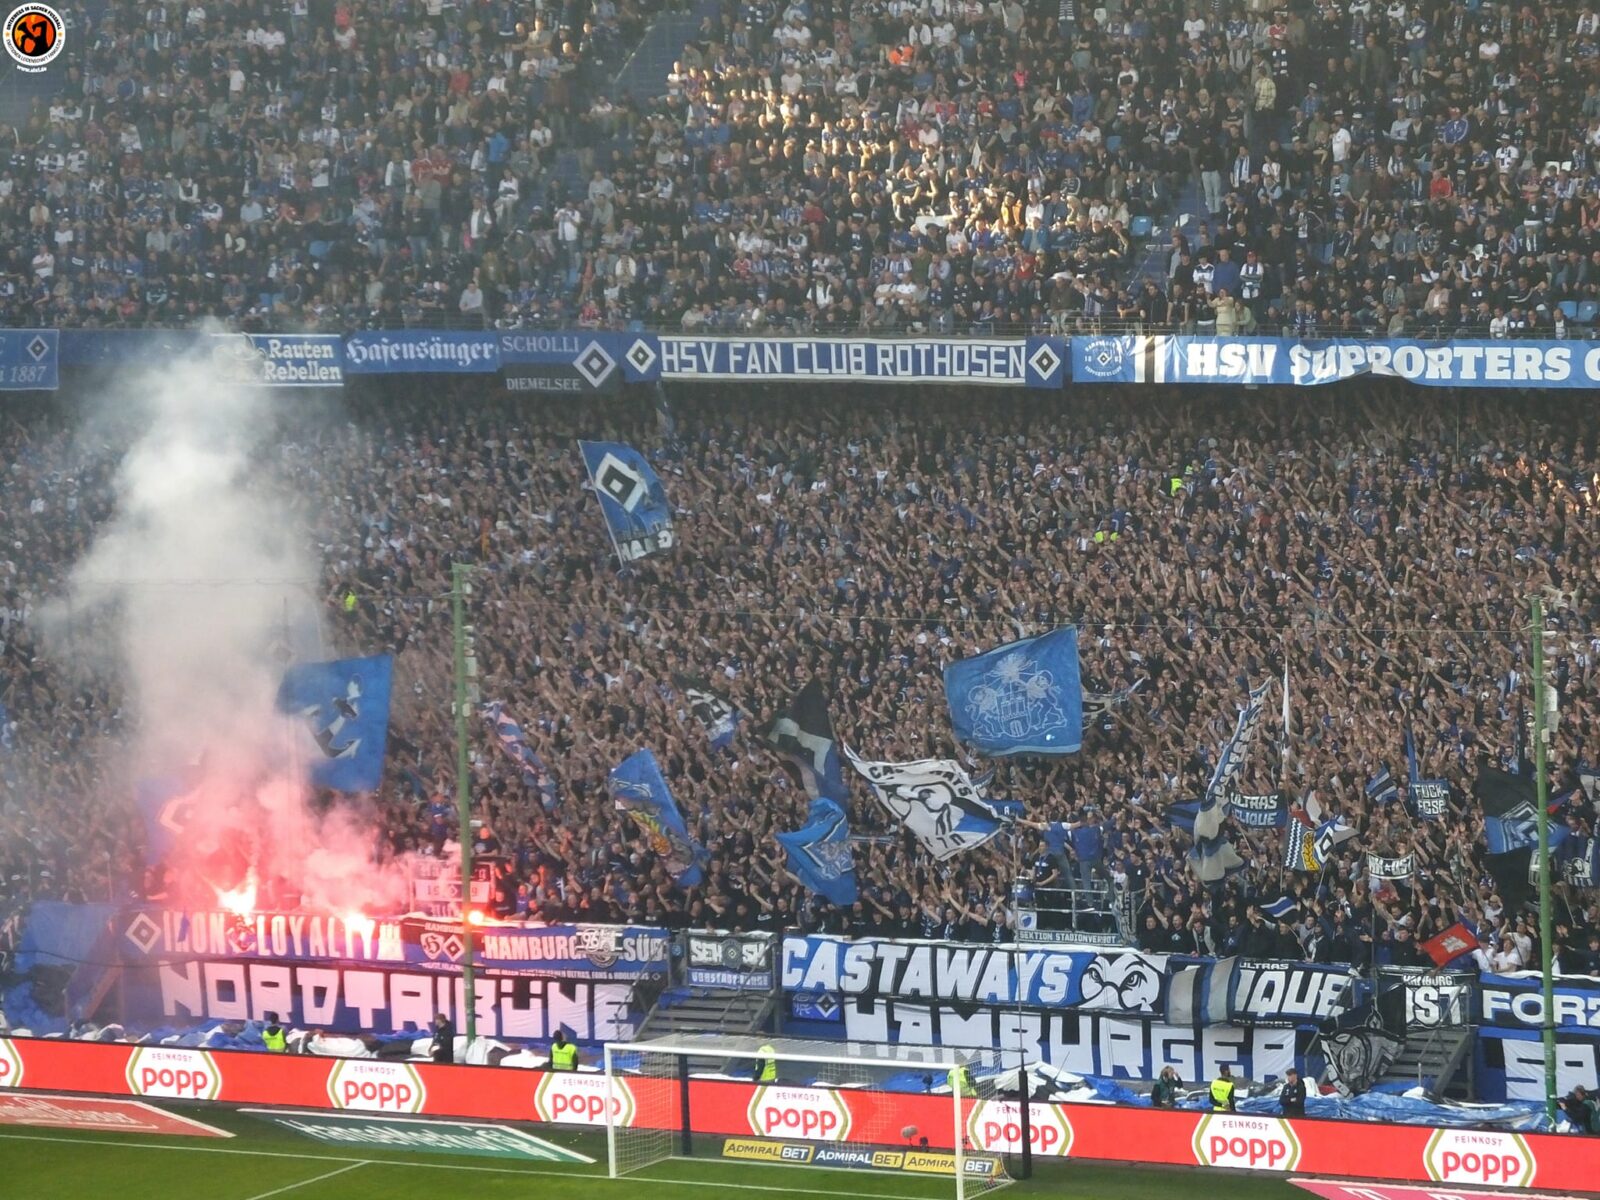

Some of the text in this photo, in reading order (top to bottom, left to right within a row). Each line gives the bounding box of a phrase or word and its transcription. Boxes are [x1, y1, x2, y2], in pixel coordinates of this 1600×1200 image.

[269, 339, 333, 359] Rauten
[346, 336, 497, 367] Hafensänger
[503, 336, 579, 353] SCHOLLI
[661, 341, 1026, 378] HSV FAN CLUB ROTHOSEN
[1186, 343, 1276, 377] HSV
[1290, 343, 1571, 384] SUPPORTERS
[10, 366, 47, 383] 1887
[264, 360, 341, 381] Rebellen
[507, 378, 581, 391] DIEMELSEE
[1231, 792, 1278, 810] ULTRAS
[1020, 930, 1117, 944] SEKTION STADIONVERBOT
[782, 938, 1072, 1003] CASTAWAYS
[1240, 962, 1289, 970] ULTRAS
[1403, 974, 1453, 986] HAMBURG
[158, 960, 634, 1041] NORDTRIBÜNE
[846, 998, 1296, 1083] HAMBURGER
[142, 1067, 208, 1096] popp
[344, 1080, 411, 1109] popp
[776, 1093, 821, 1103] FEINKOST
[552, 1092, 621, 1122] popp
[996, 1106, 1042, 1116] FEINST
[765, 1107, 837, 1137] popp
[1223, 1120, 1269, 1131] FEINKOST
[1211, 1136, 1286, 1167] popp
[1455, 1136, 1503, 1147] FEINKOST
[1443, 1151, 1520, 1182] popp
